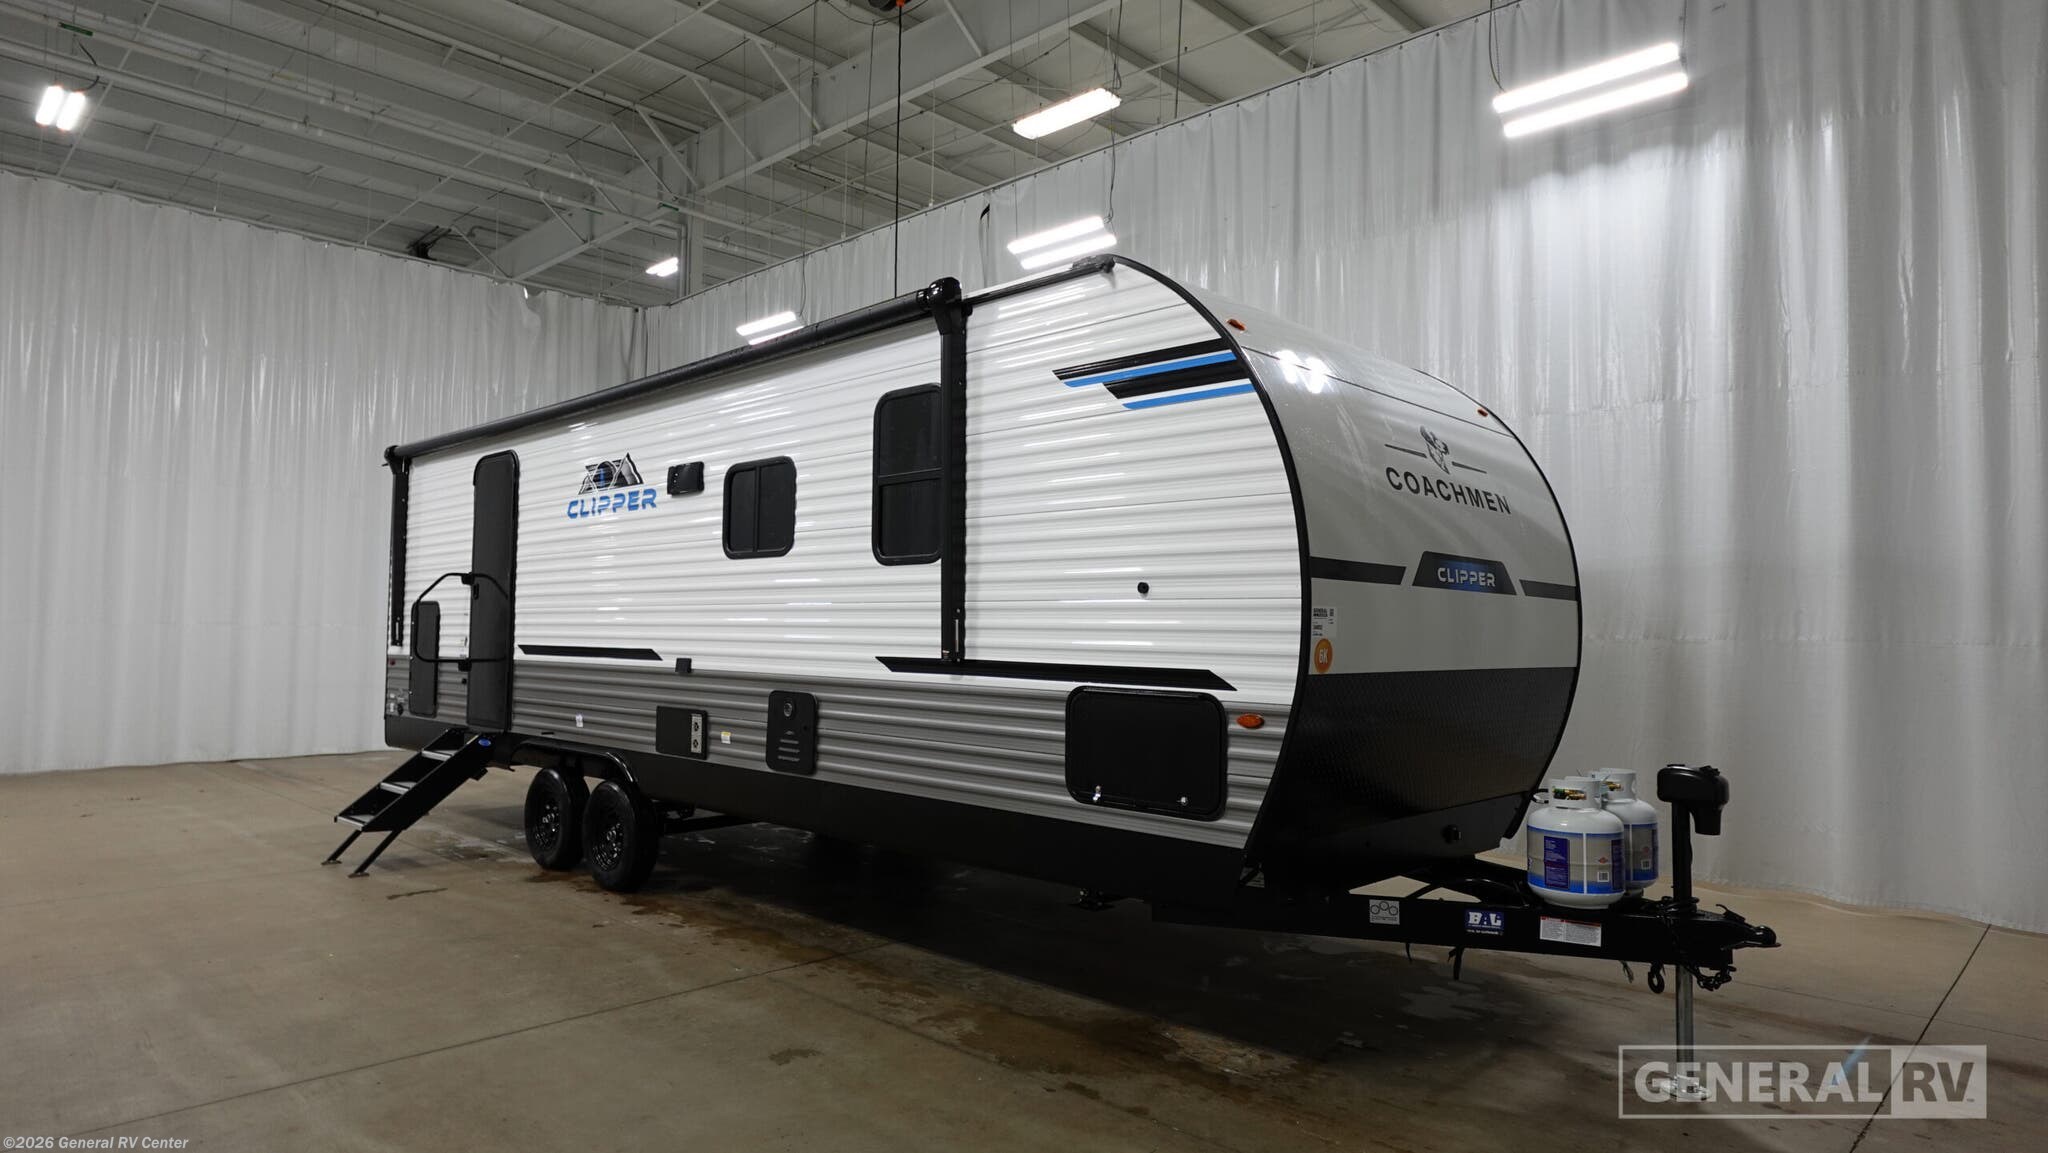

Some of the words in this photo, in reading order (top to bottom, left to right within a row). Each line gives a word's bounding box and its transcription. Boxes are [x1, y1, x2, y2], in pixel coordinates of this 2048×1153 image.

[567, 488, 657, 519] CLIPPER
[1386, 466, 1511, 514] COACHMEN
[1437, 567, 1496, 587] CLIPPER
